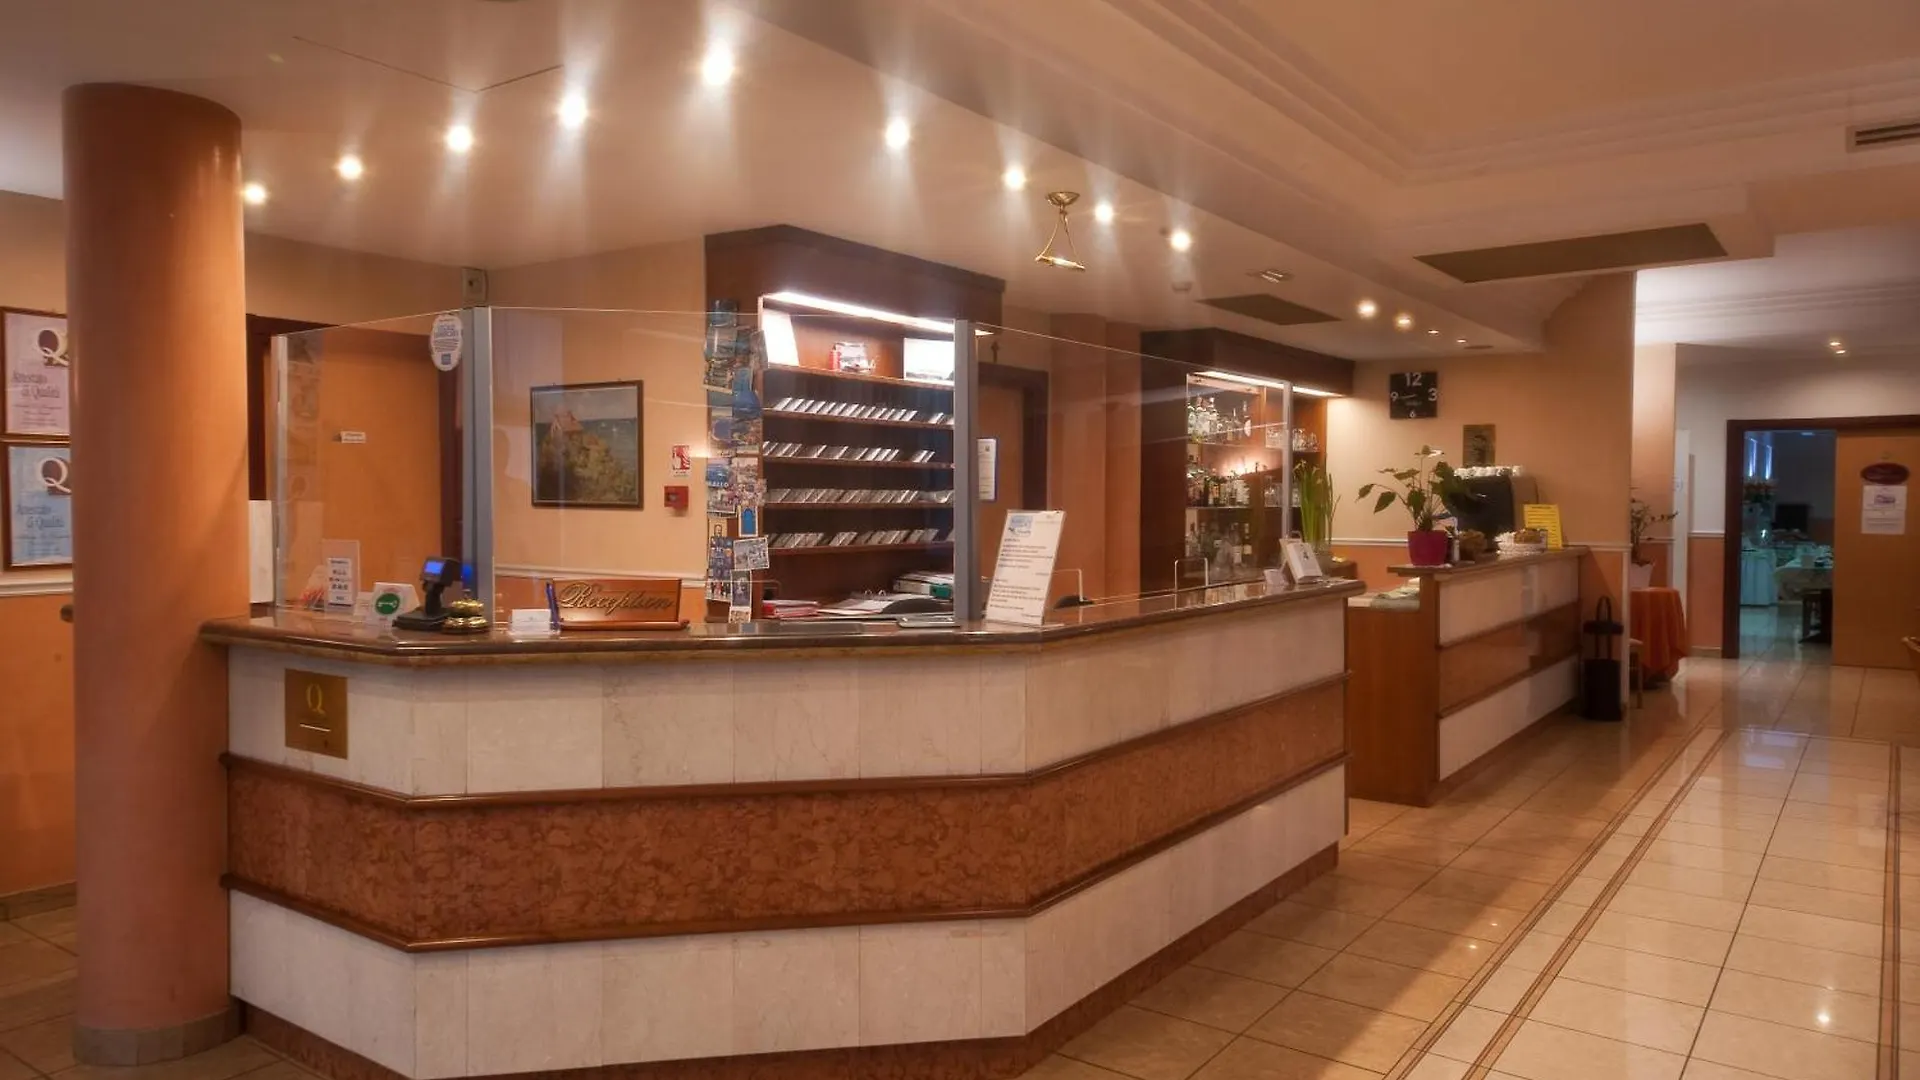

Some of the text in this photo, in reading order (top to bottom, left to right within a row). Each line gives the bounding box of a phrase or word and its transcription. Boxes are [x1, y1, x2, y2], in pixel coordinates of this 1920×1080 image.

[1405, 372, 1422, 387] 12
[1390, 387, 1438, 402] 9 3
[1409, 410, 1416, 418] 6
[560, 581, 674, 616] Reception
[306, 683, 326, 717] Q
